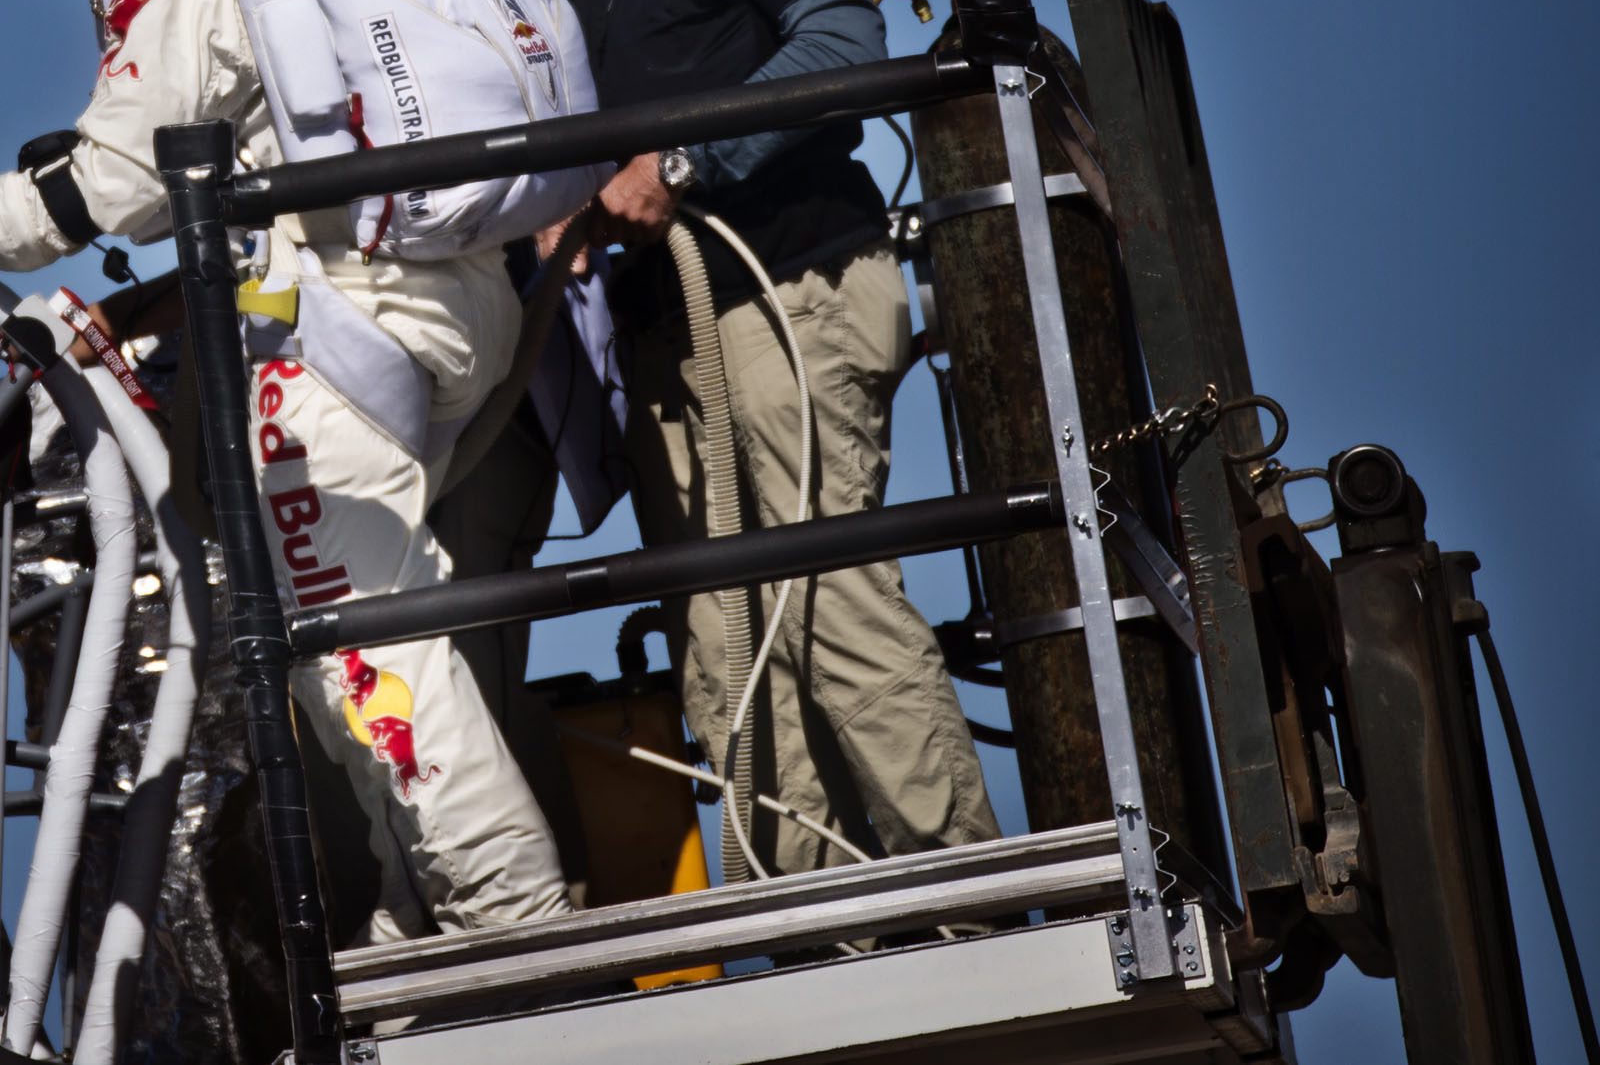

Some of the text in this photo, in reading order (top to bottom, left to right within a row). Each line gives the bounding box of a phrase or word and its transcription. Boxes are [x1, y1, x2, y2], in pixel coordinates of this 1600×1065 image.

[86, 324, 143, 398] REMOVE BEFORE FLIGHT
[268, 485, 353, 609] Bull
